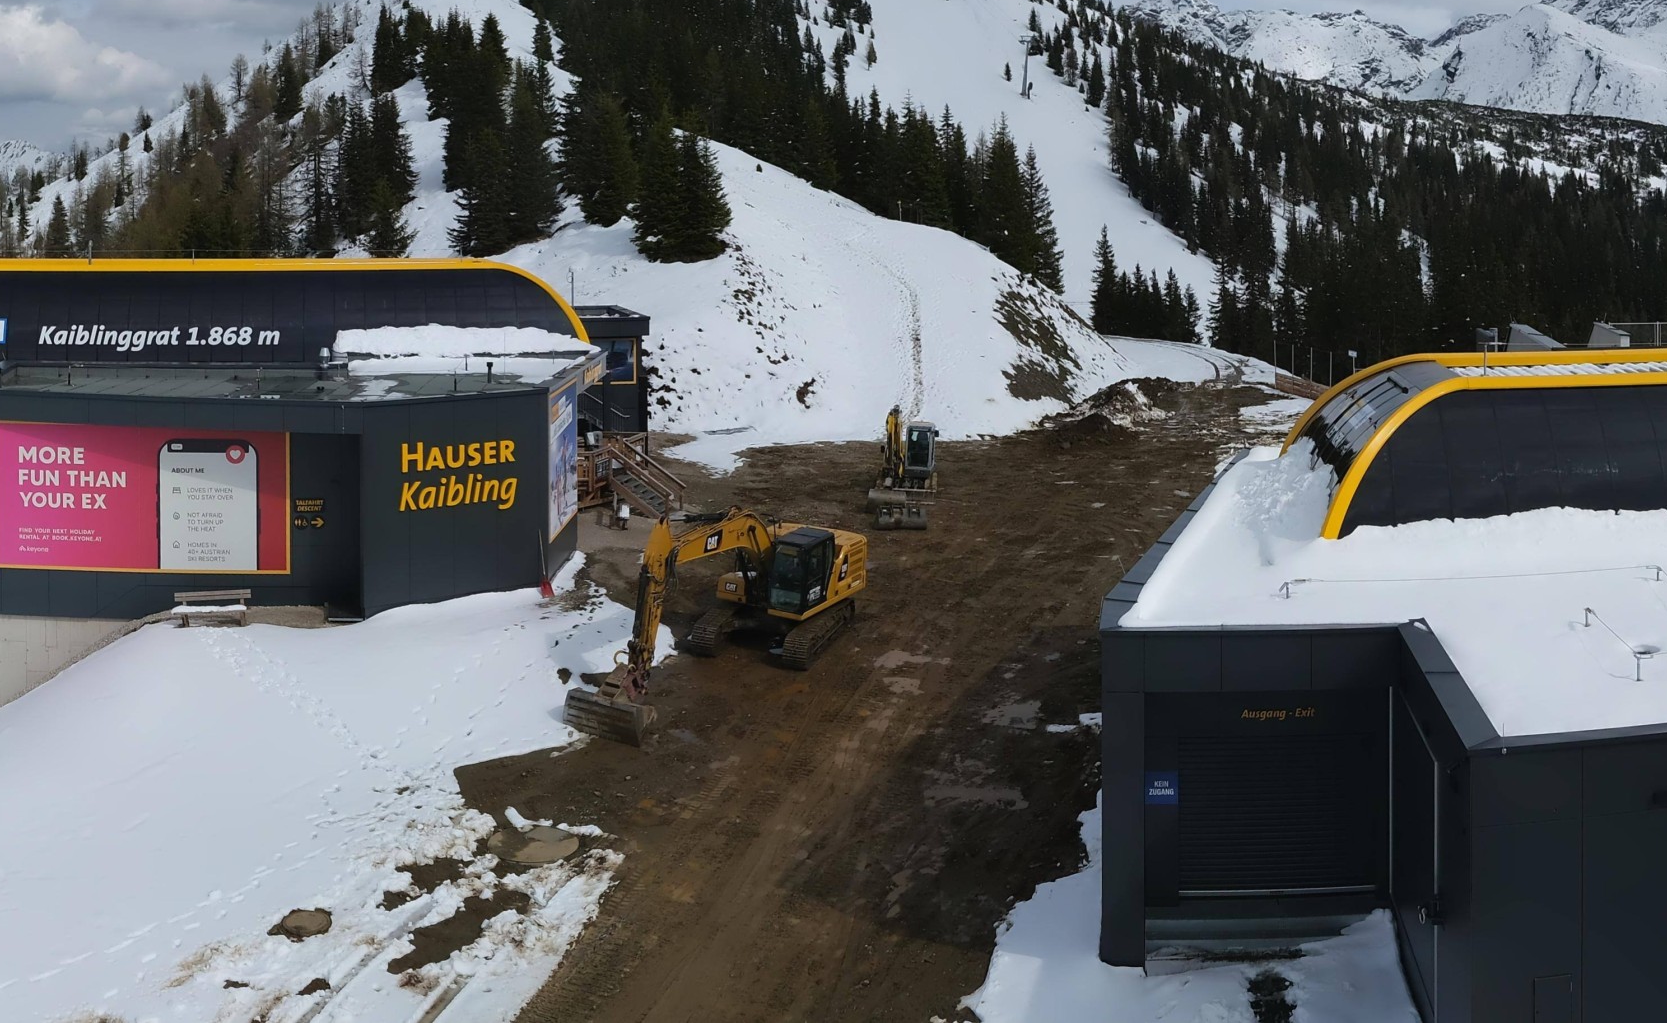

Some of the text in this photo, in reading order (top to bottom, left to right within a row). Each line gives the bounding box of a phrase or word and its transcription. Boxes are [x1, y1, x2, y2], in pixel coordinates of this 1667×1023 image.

[38, 325, 280, 352] Kaiblinggrat 1.868 m
[18, 446, 85, 464] MORE
[401, 440, 516, 473] HAUSER
[18, 469, 127, 488] FUN THAN
[19, 492, 107, 509] YOUR EX
[398, 473, 518, 512] Kaibling
[707, 535, 718, 550] CAT
[1241, 708, 1287, 721] Ausgang
[1295, 707, 1316, 718] Exit
[1148, 788, 1175, 796] ZUGANG
[1154, 780, 1169, 788] KEIN
